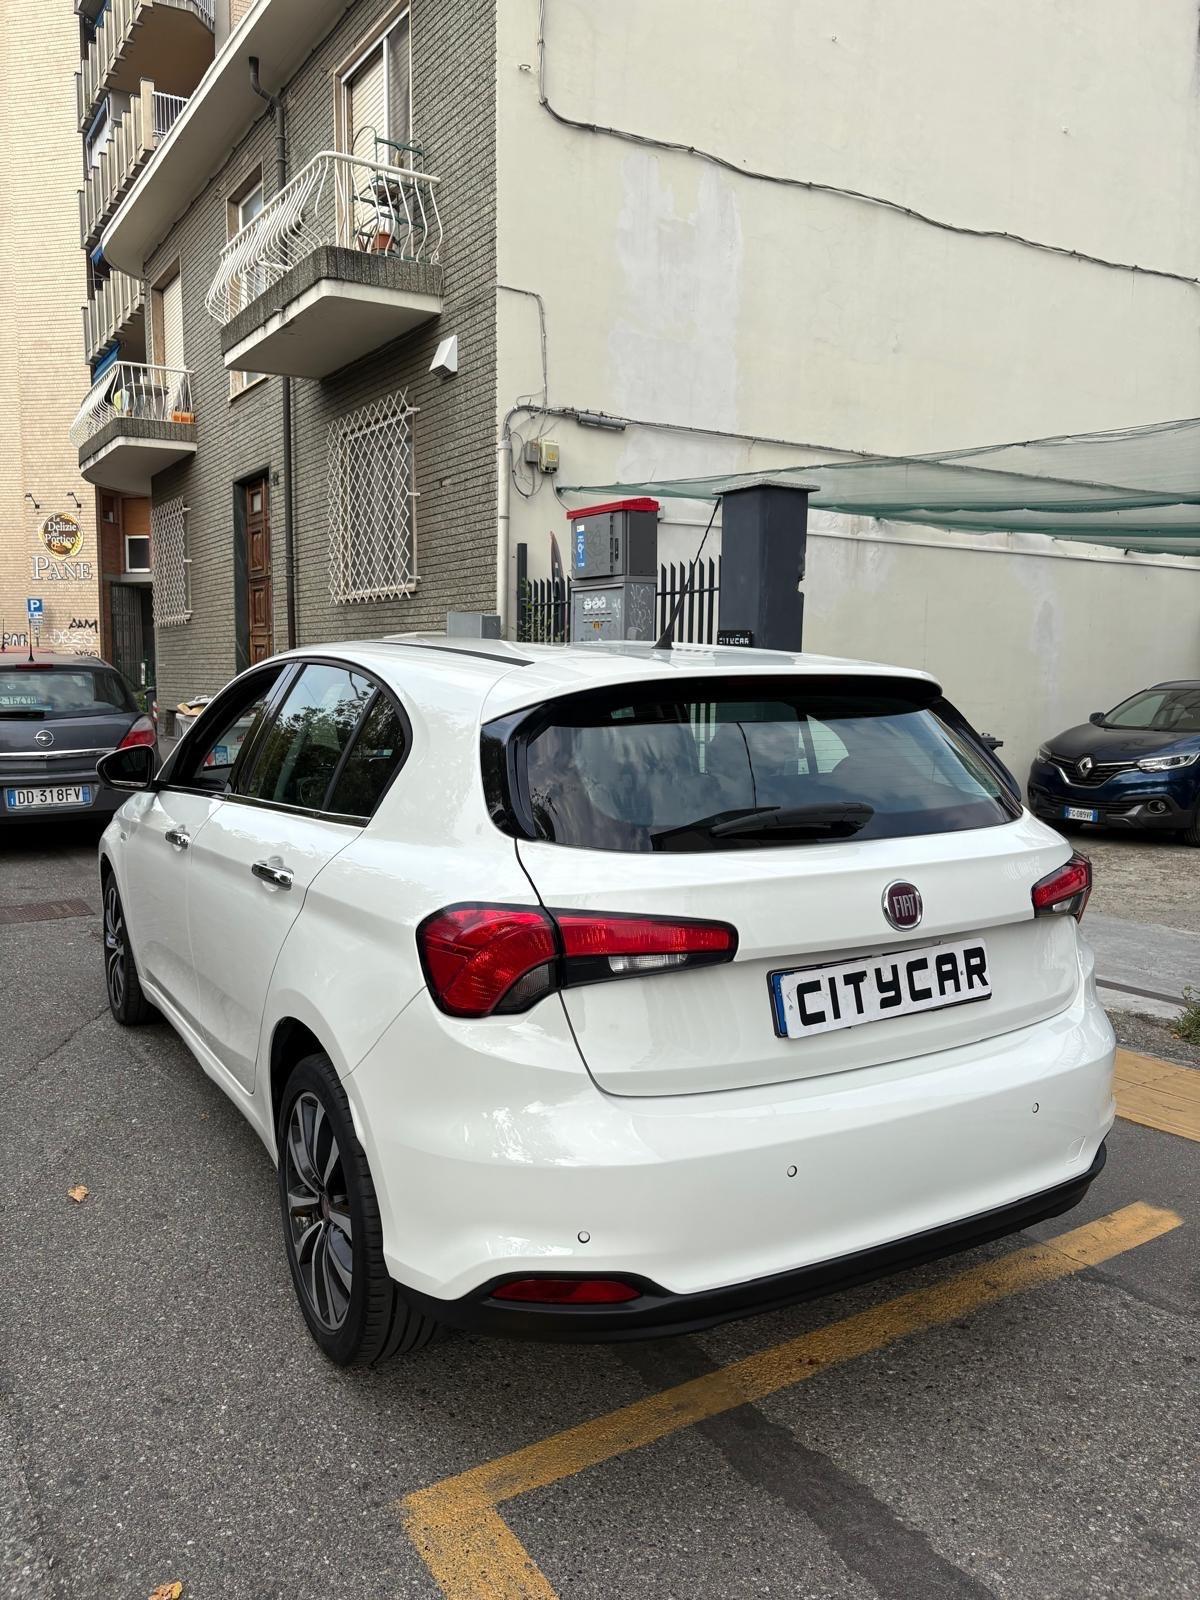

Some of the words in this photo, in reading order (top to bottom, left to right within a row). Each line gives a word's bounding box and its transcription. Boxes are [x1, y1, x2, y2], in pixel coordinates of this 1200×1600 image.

[48, 521, 77, 532] Delizie
[45, 533, 76, 544] Portico
[31, 555, 93, 580] PANE
[30, 600, 40, 611] P
[893, 893, 915, 918] FIAT
[797, 946, 988, 1026] CITYCAR
